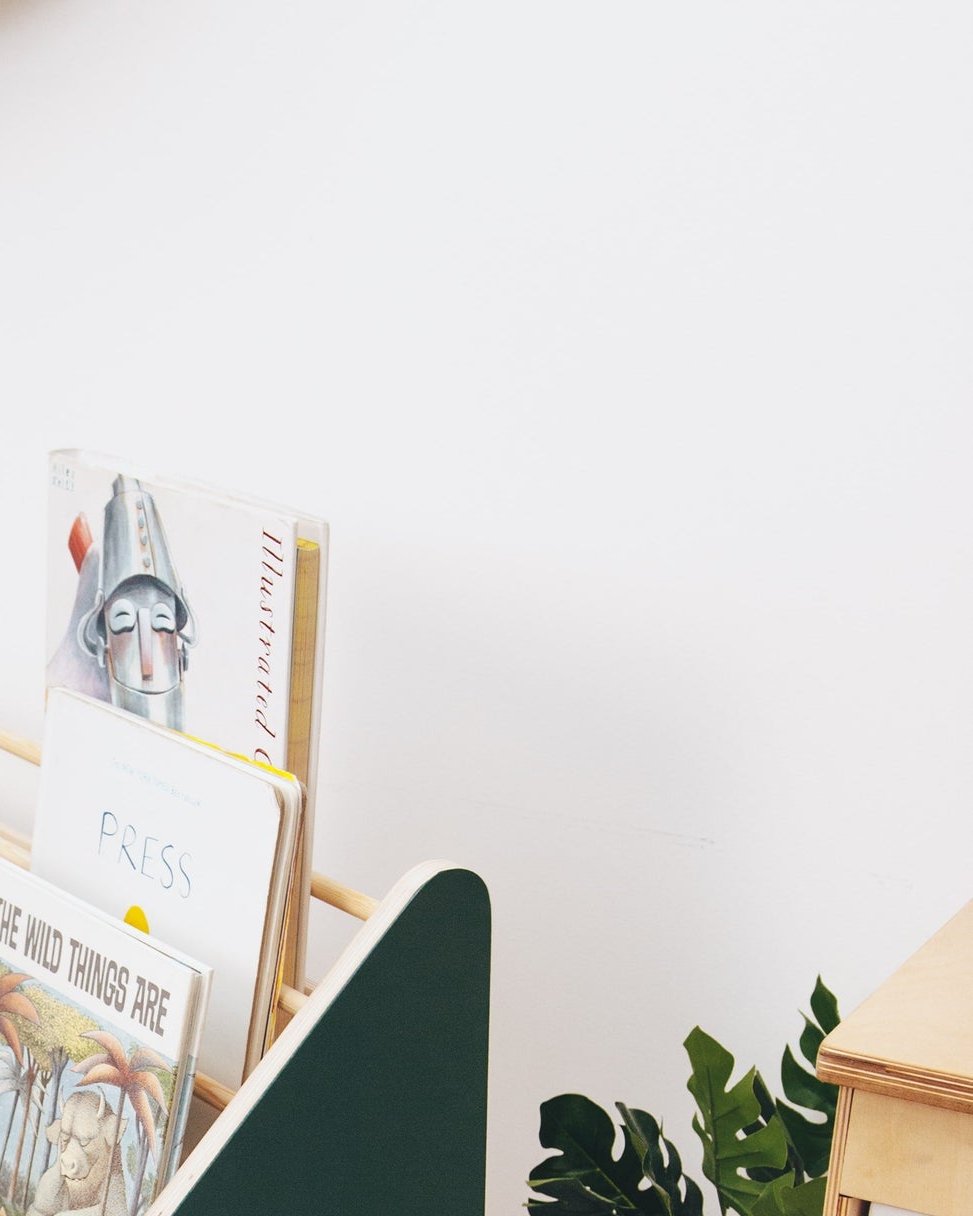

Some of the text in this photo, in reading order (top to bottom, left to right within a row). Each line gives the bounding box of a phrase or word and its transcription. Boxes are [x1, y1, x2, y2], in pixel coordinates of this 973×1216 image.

[253, 526, 284, 739] Illustrated
[97, 811, 194, 899] PRESS
[23, 912, 64, 974] WILD
[67, 937, 131, 1014] THINGS
[130, 975, 171, 1037] ARE
